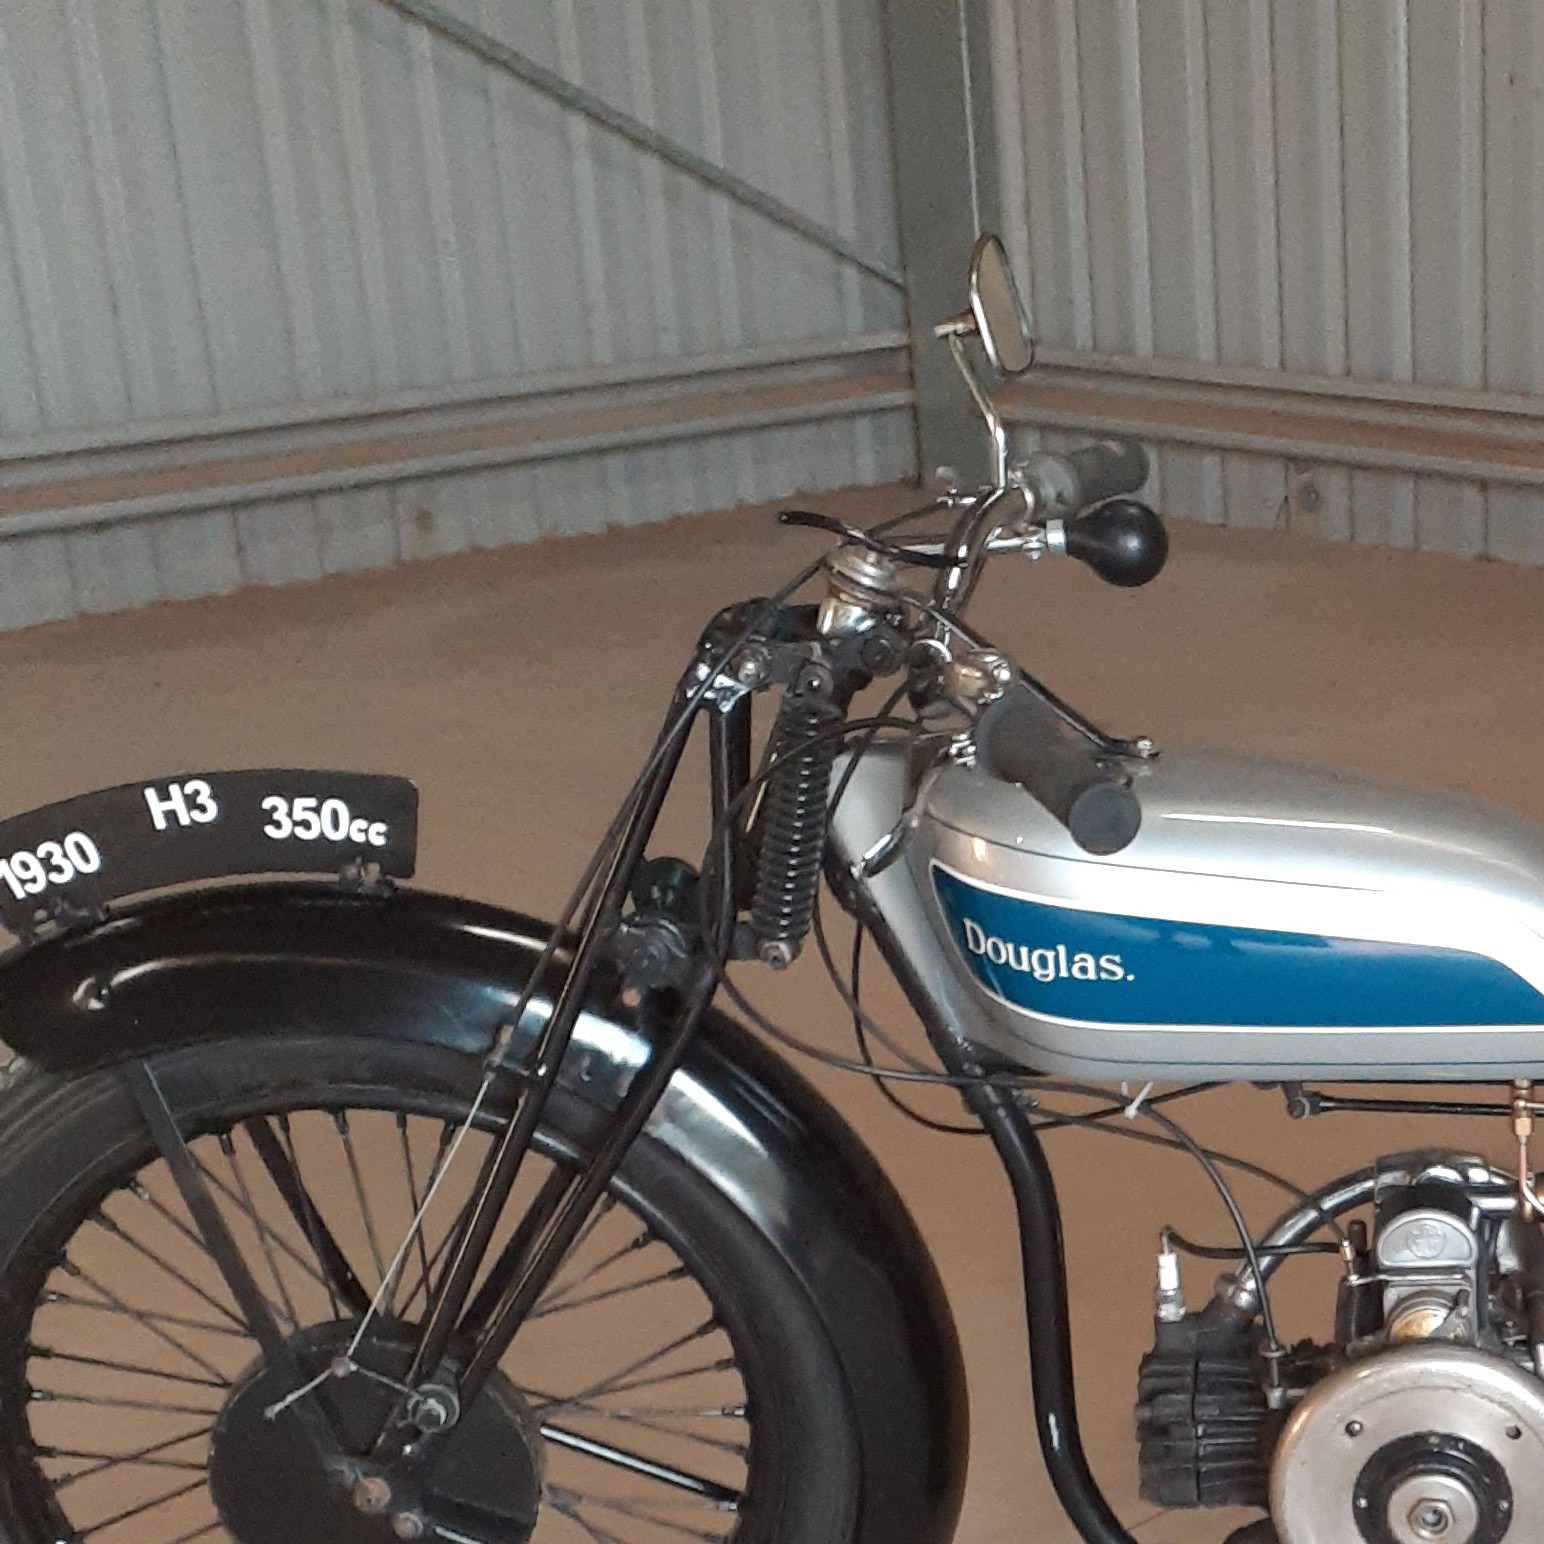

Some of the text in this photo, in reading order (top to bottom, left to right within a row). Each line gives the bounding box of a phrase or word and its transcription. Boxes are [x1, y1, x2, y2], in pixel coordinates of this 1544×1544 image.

[0, 779, 388, 900] 1930 H3 350cc
[963, 917, 1135, 982] Douglas.
